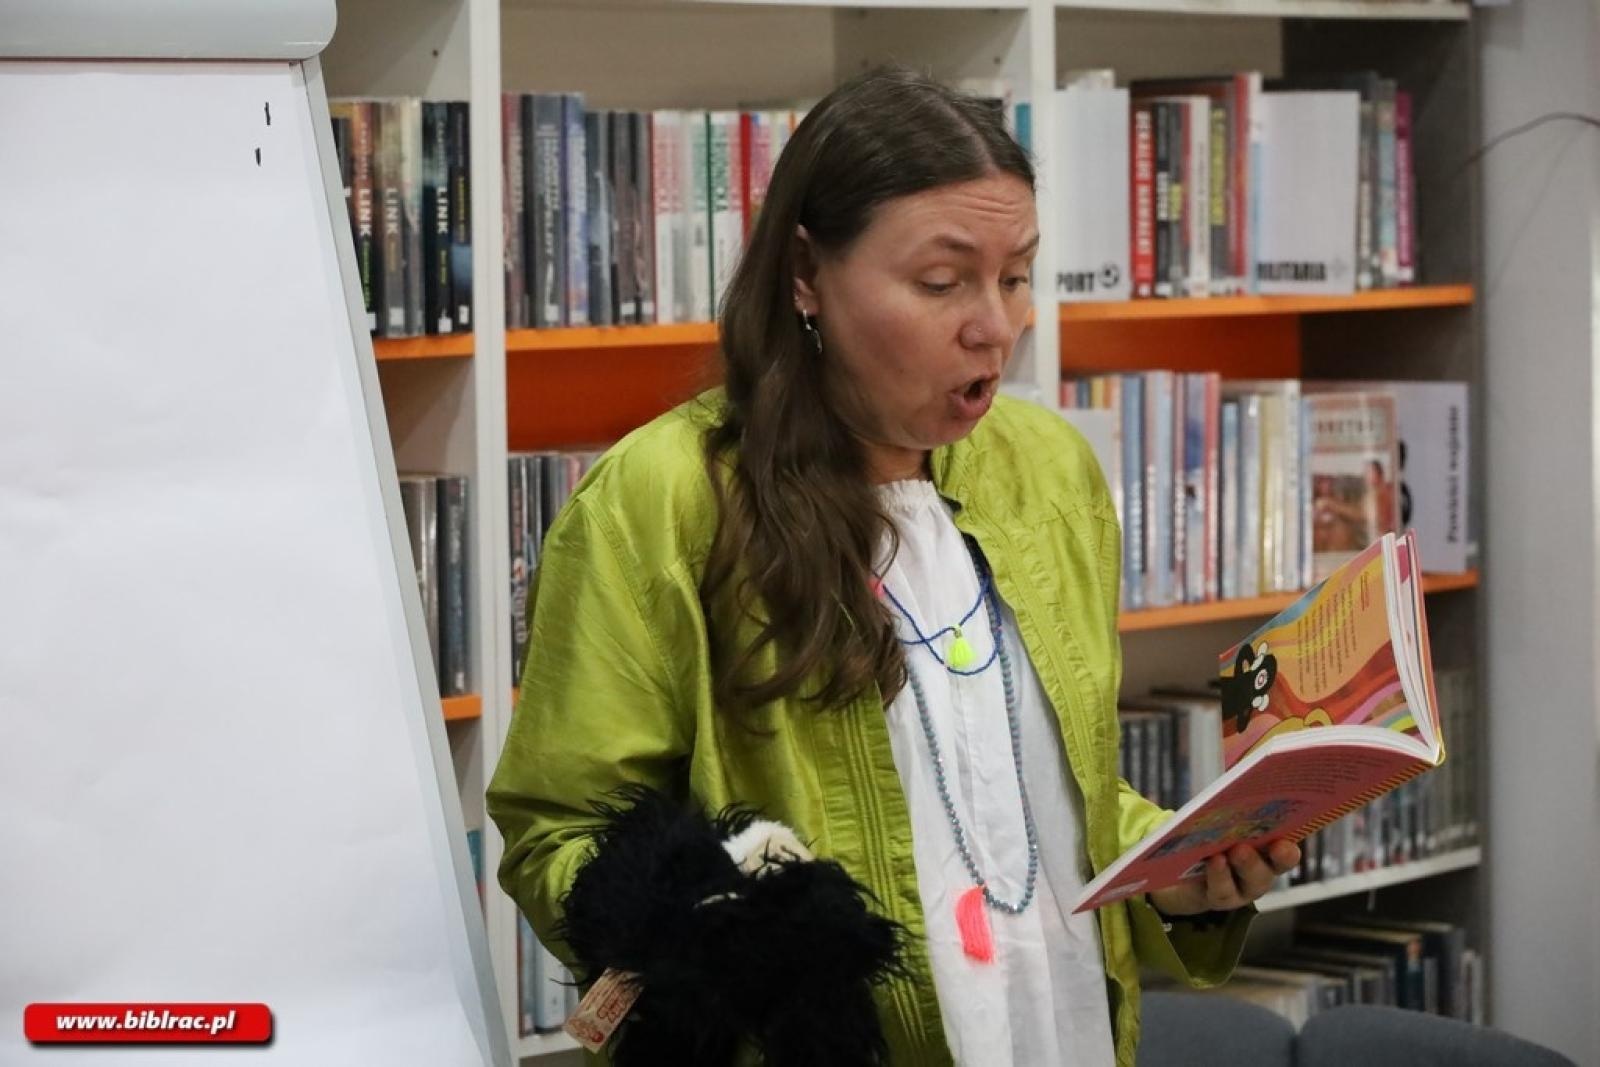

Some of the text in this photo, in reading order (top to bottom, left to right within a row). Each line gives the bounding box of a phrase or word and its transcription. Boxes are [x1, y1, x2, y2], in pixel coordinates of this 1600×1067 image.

[359, 188, 371, 237] LINK
[386, 187, 398, 235] LINK
[437, 187, 449, 234] LINK
[1056, 271, 1095, 293] PORT
